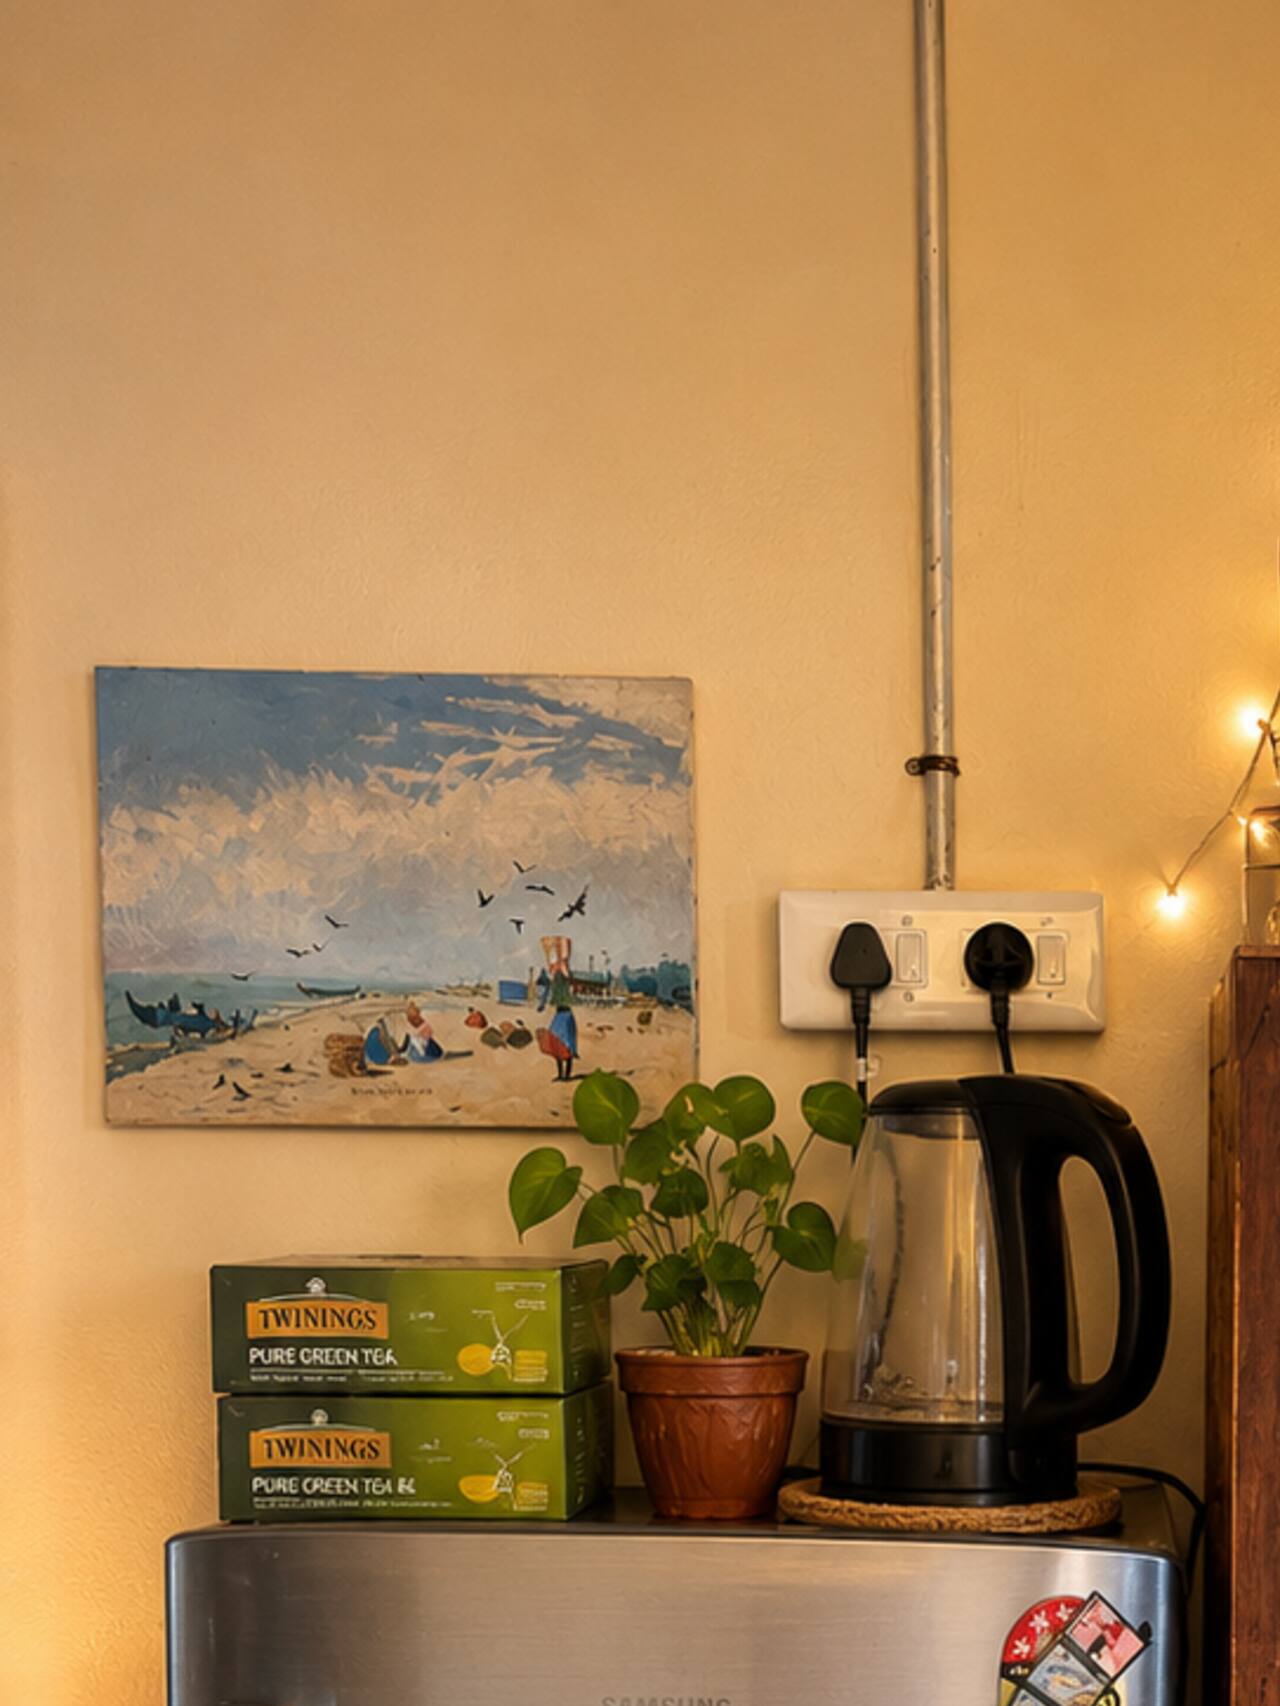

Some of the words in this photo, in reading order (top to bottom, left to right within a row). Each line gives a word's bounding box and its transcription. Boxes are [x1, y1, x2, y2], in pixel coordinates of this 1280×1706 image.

[258, 1307, 378, 1330] TWININGS
[249, 1347, 296, 1366] PURE
[299, 1347, 359, 1366] GREEN
[361, 1347, 399, 1366] TEA
[263, 1437, 381, 1460] TWININGS
[251, 1476, 299, 1495] PURE
[302, 1476, 359, 1495] GREEN
